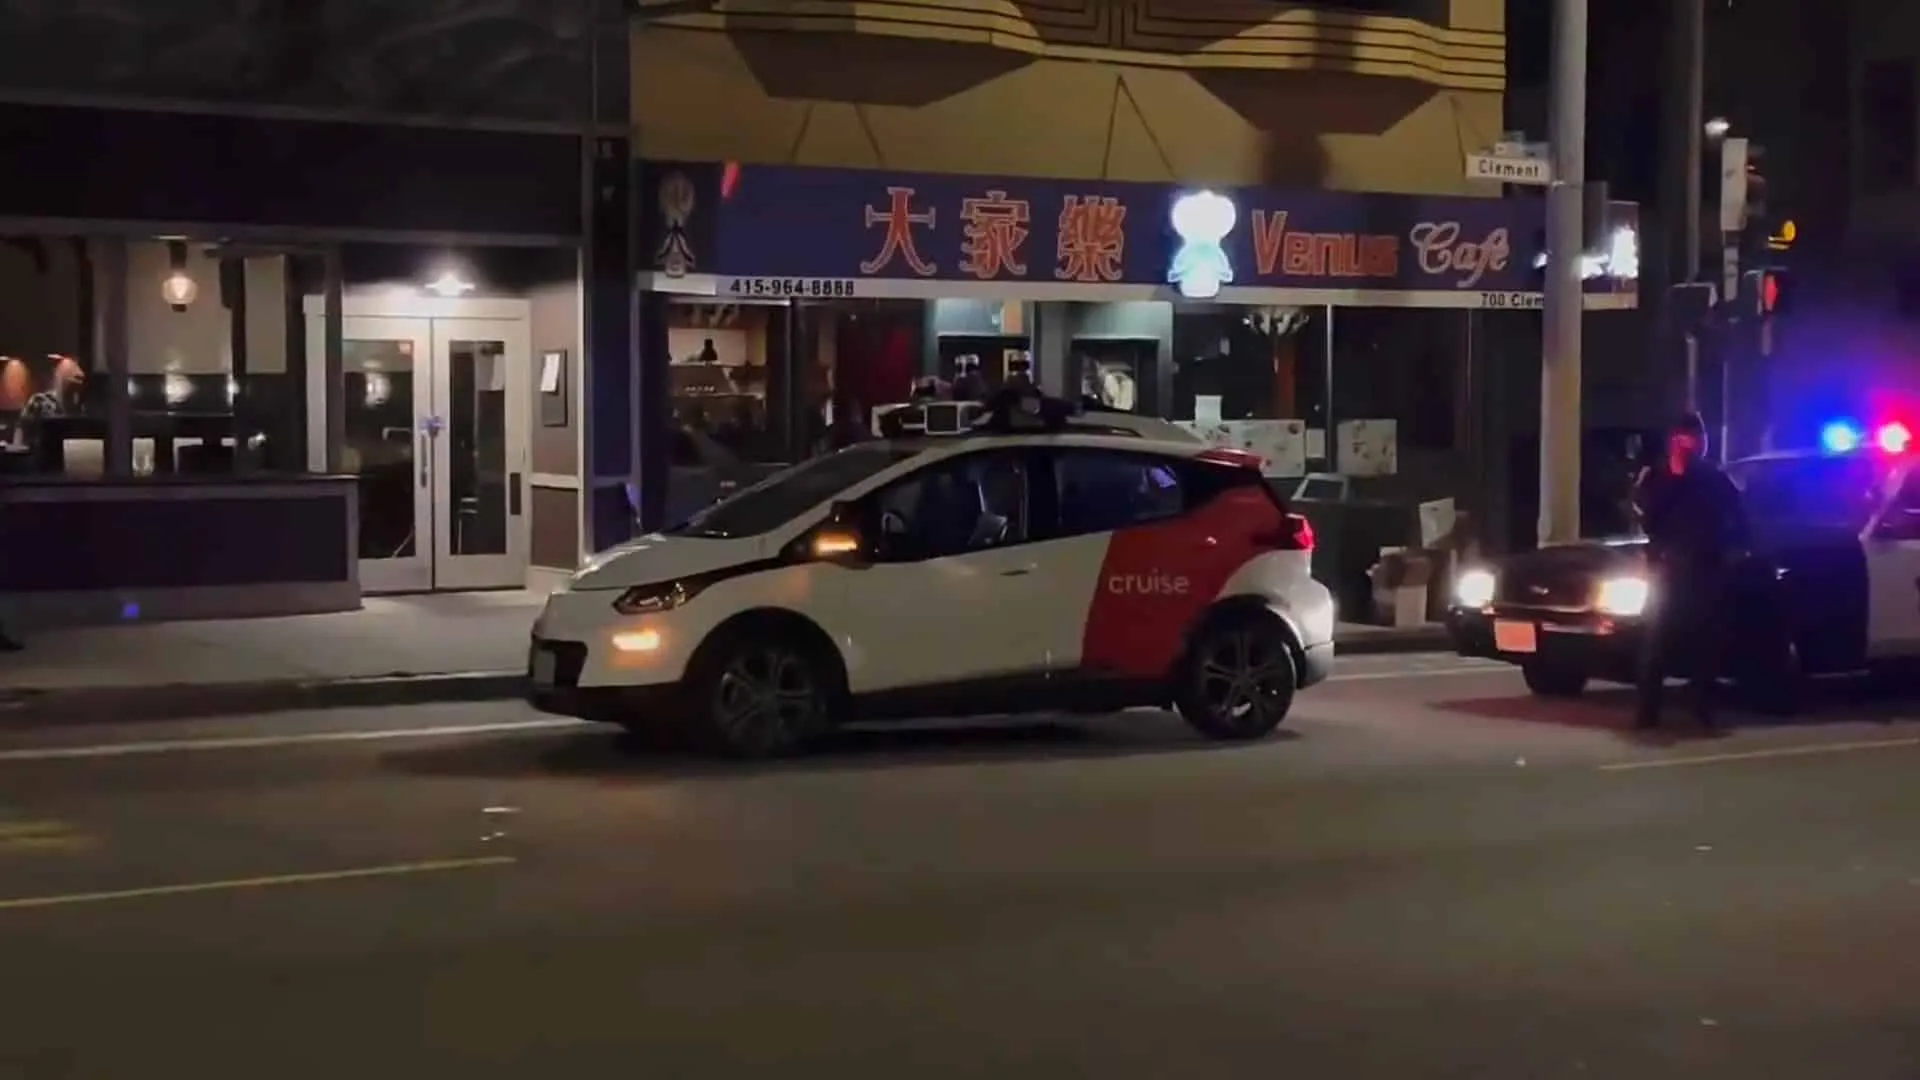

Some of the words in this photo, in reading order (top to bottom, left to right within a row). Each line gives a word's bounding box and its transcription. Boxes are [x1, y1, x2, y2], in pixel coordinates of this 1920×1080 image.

[1478, 158, 1539, 177] Clement
[860, 186, 1126, 282] 大家樂
[729, 279, 855, 296] 415-964-8888
[1481, 293, 1505, 306] 700
[1108, 567, 1190, 595] cruise
